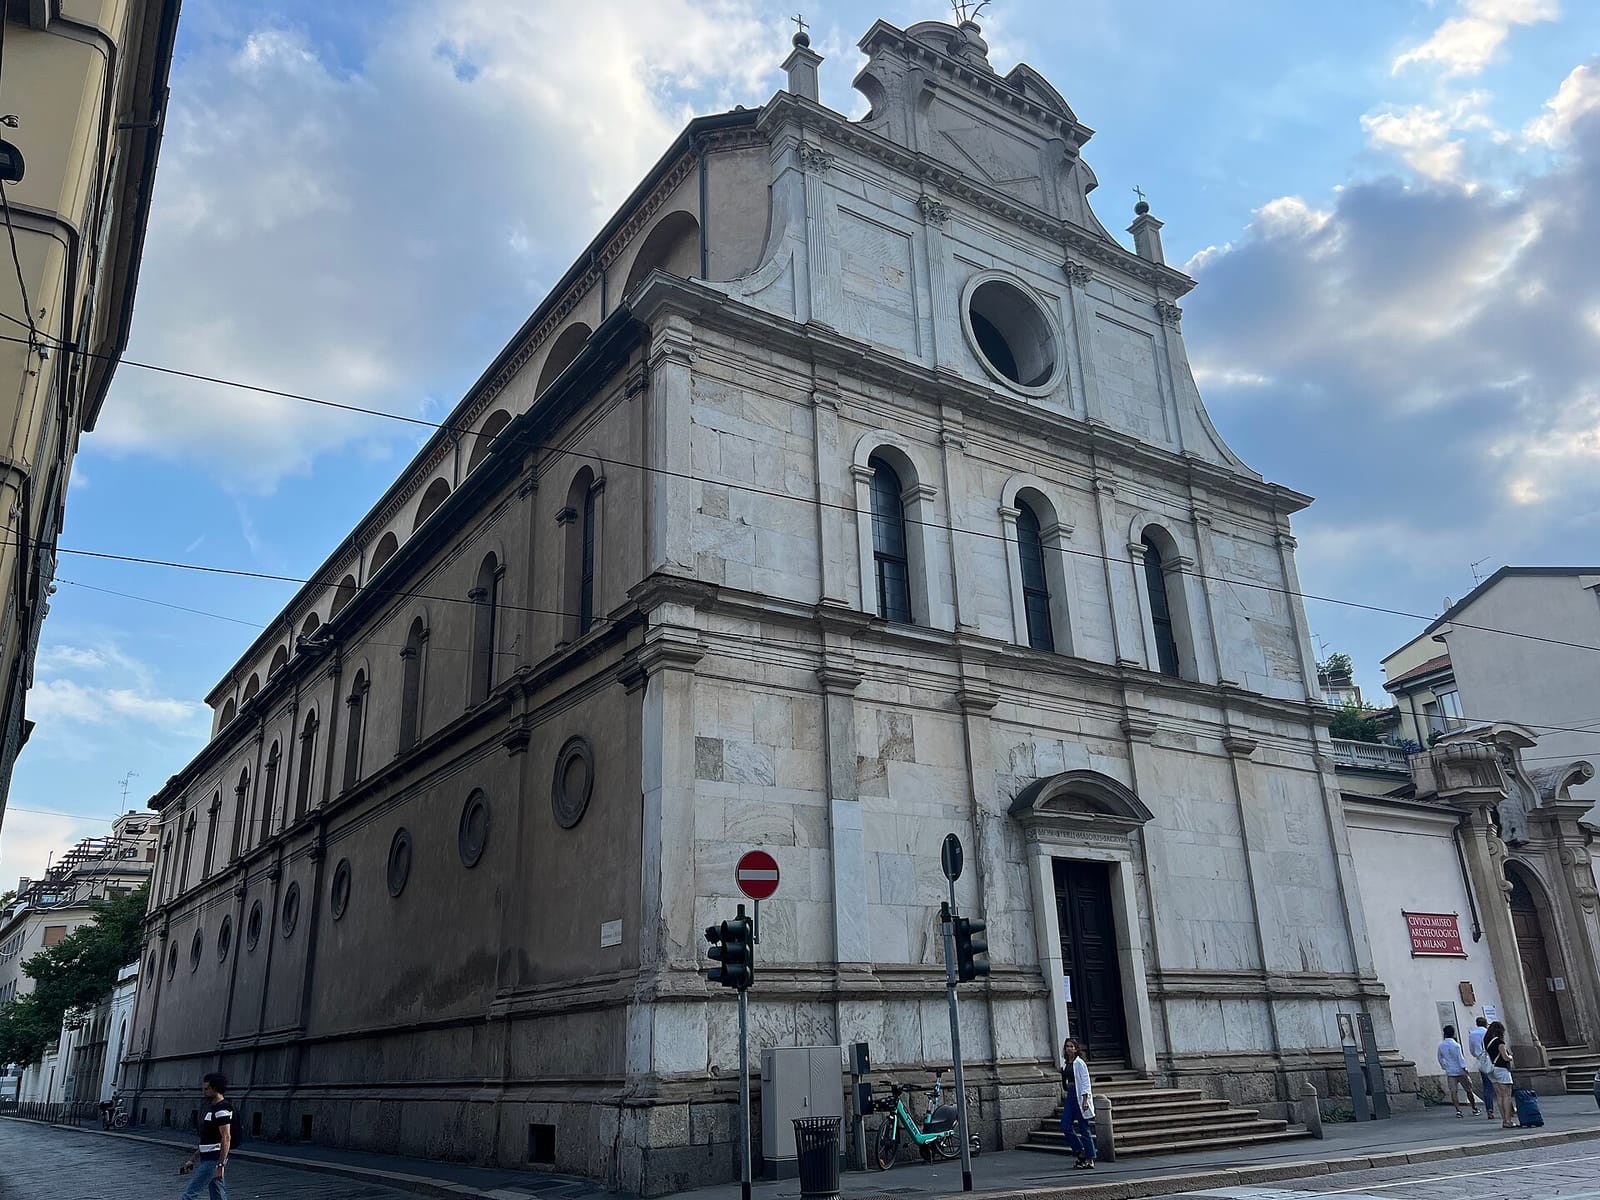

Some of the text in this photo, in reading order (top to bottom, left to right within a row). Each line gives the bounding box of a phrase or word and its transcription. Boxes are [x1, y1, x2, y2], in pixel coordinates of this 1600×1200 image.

[1408, 916, 1452, 927] CIVICO MUSEO
[1411, 928, 1458, 938] ARCHEOLOGICO
[1413, 939, 1421, 948] DI
[1422, 939, 1447, 949] MILANO
